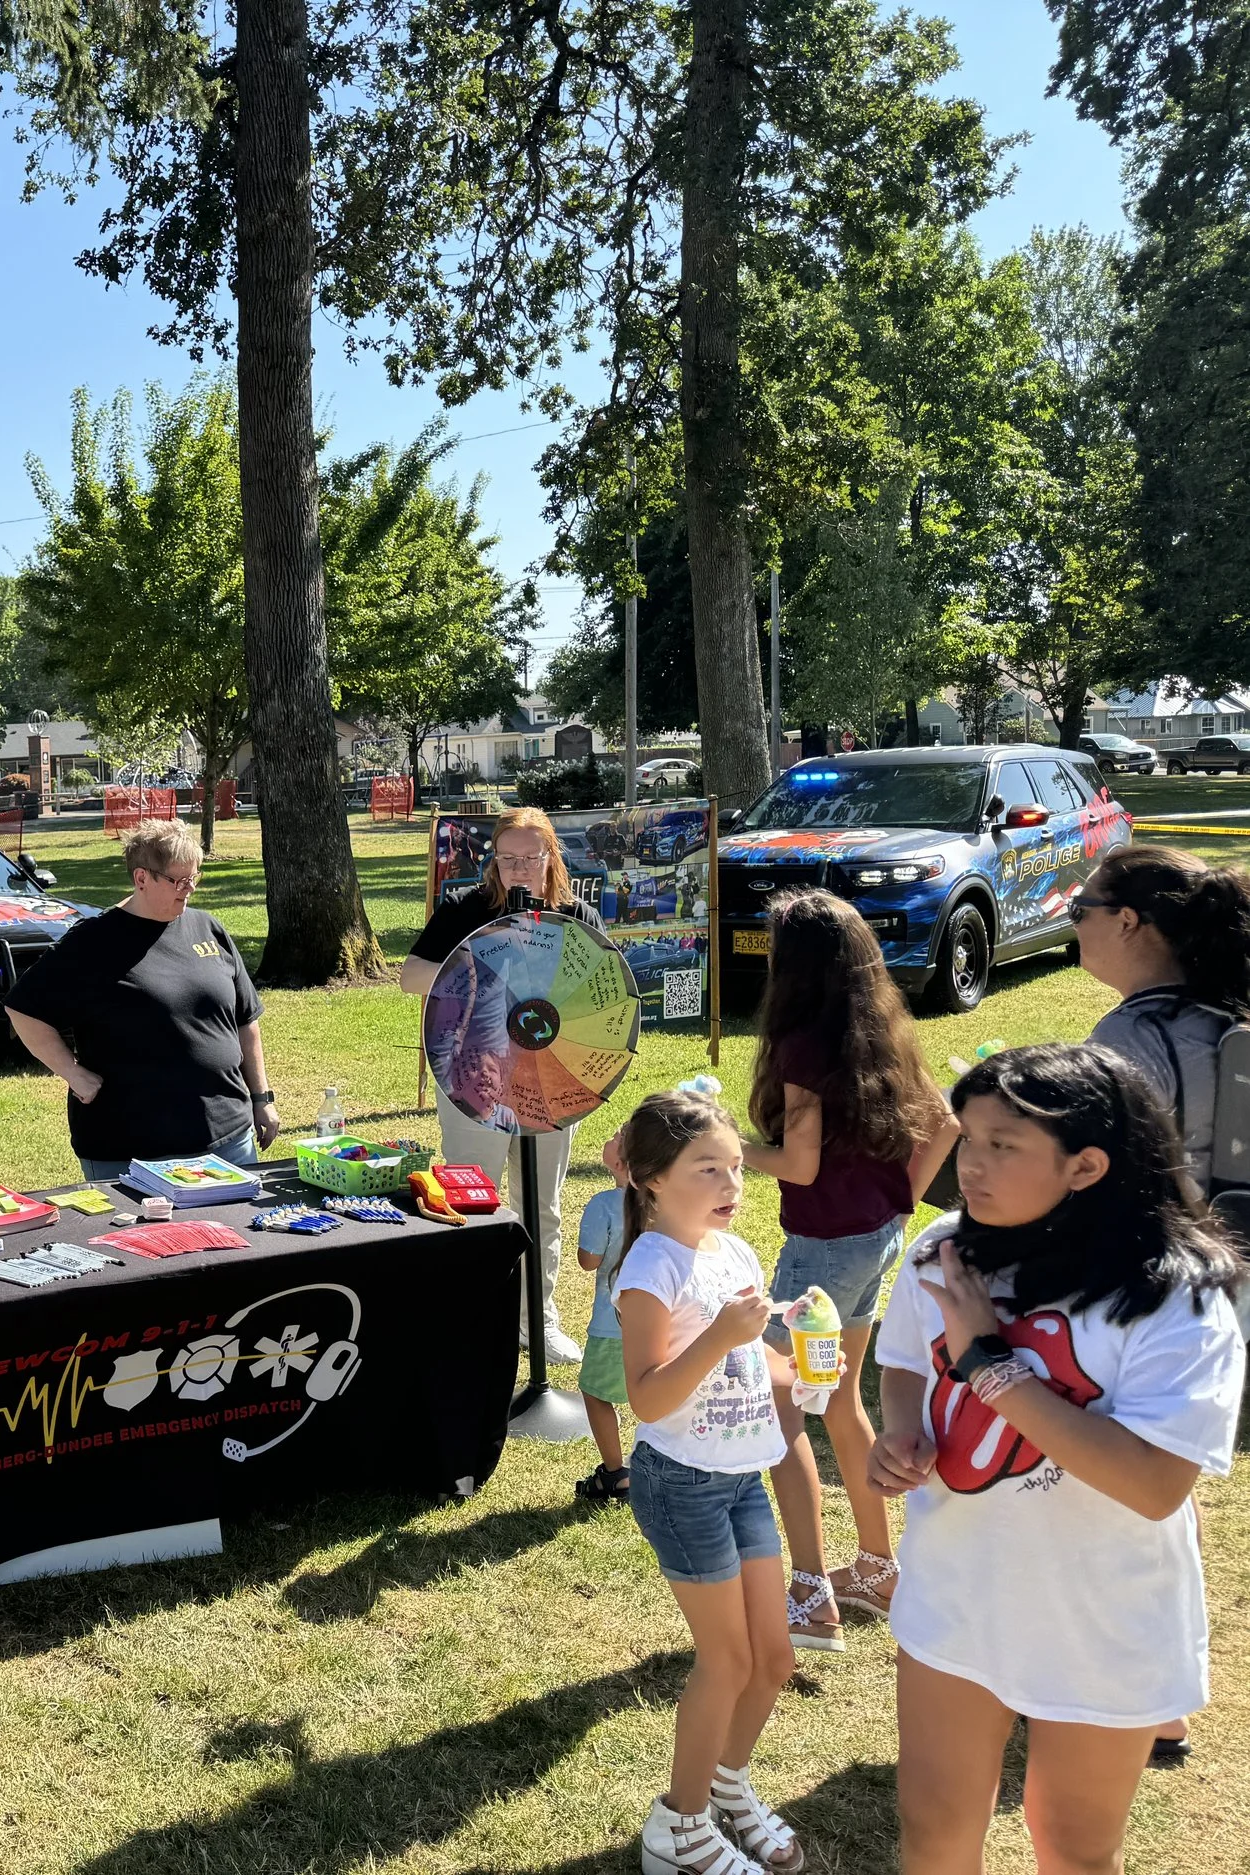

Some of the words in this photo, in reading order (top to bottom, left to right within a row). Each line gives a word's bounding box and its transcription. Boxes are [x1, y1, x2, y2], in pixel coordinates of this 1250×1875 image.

[841, 737, 854, 745] STOP
[1018, 842, 1081, 883] POLICE
[543, 932, 557, 941] your
[192, 940, 220, 956] 911
[478, 938, 512, 960] Freebie!
[467, 1188, 489, 1198] 911
[141, 1314, 218, 1343] 9-1-1
[806, 1340, 816, 1350] BE
[818, 1339, 836, 1350] GOOD
[807, 1350, 817, 1360] DO
[819, 1350, 836, 1360] GOOD
[821, 1360, 836, 1369] GOOD
[120, 1412, 220, 1441] EMERGENCY
[223, 1399, 302, 1422] DISPATCH
[706, 1403, 772, 1428] together
